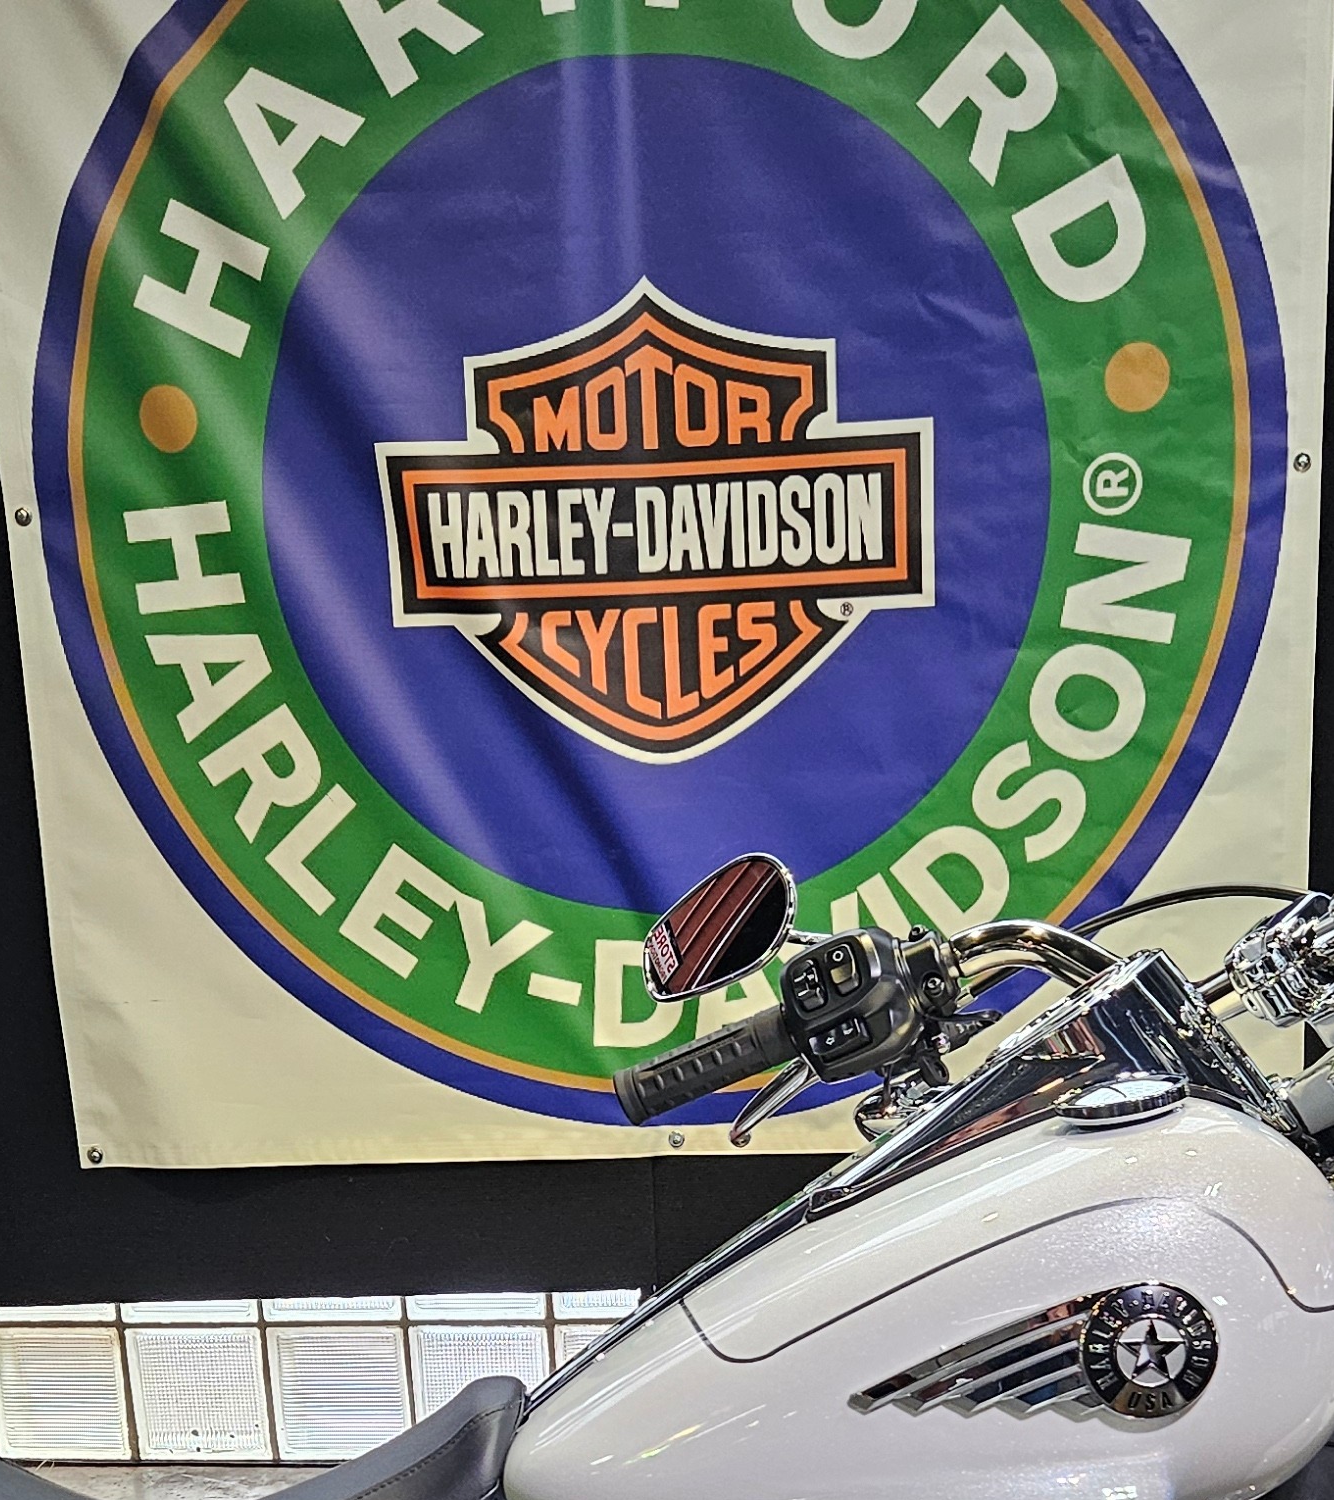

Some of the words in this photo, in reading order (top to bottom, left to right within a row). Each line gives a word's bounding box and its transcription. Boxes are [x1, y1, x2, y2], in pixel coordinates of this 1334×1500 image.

[133, 0, 1147, 357] HARRD
[533, 344, 771, 453] MOTOR
[427, 472, 884, 579] HARLEY-DAVIDSON
[540, 601, 779, 721] CYCLES
[1128, 1390, 1174, 1412] USA
